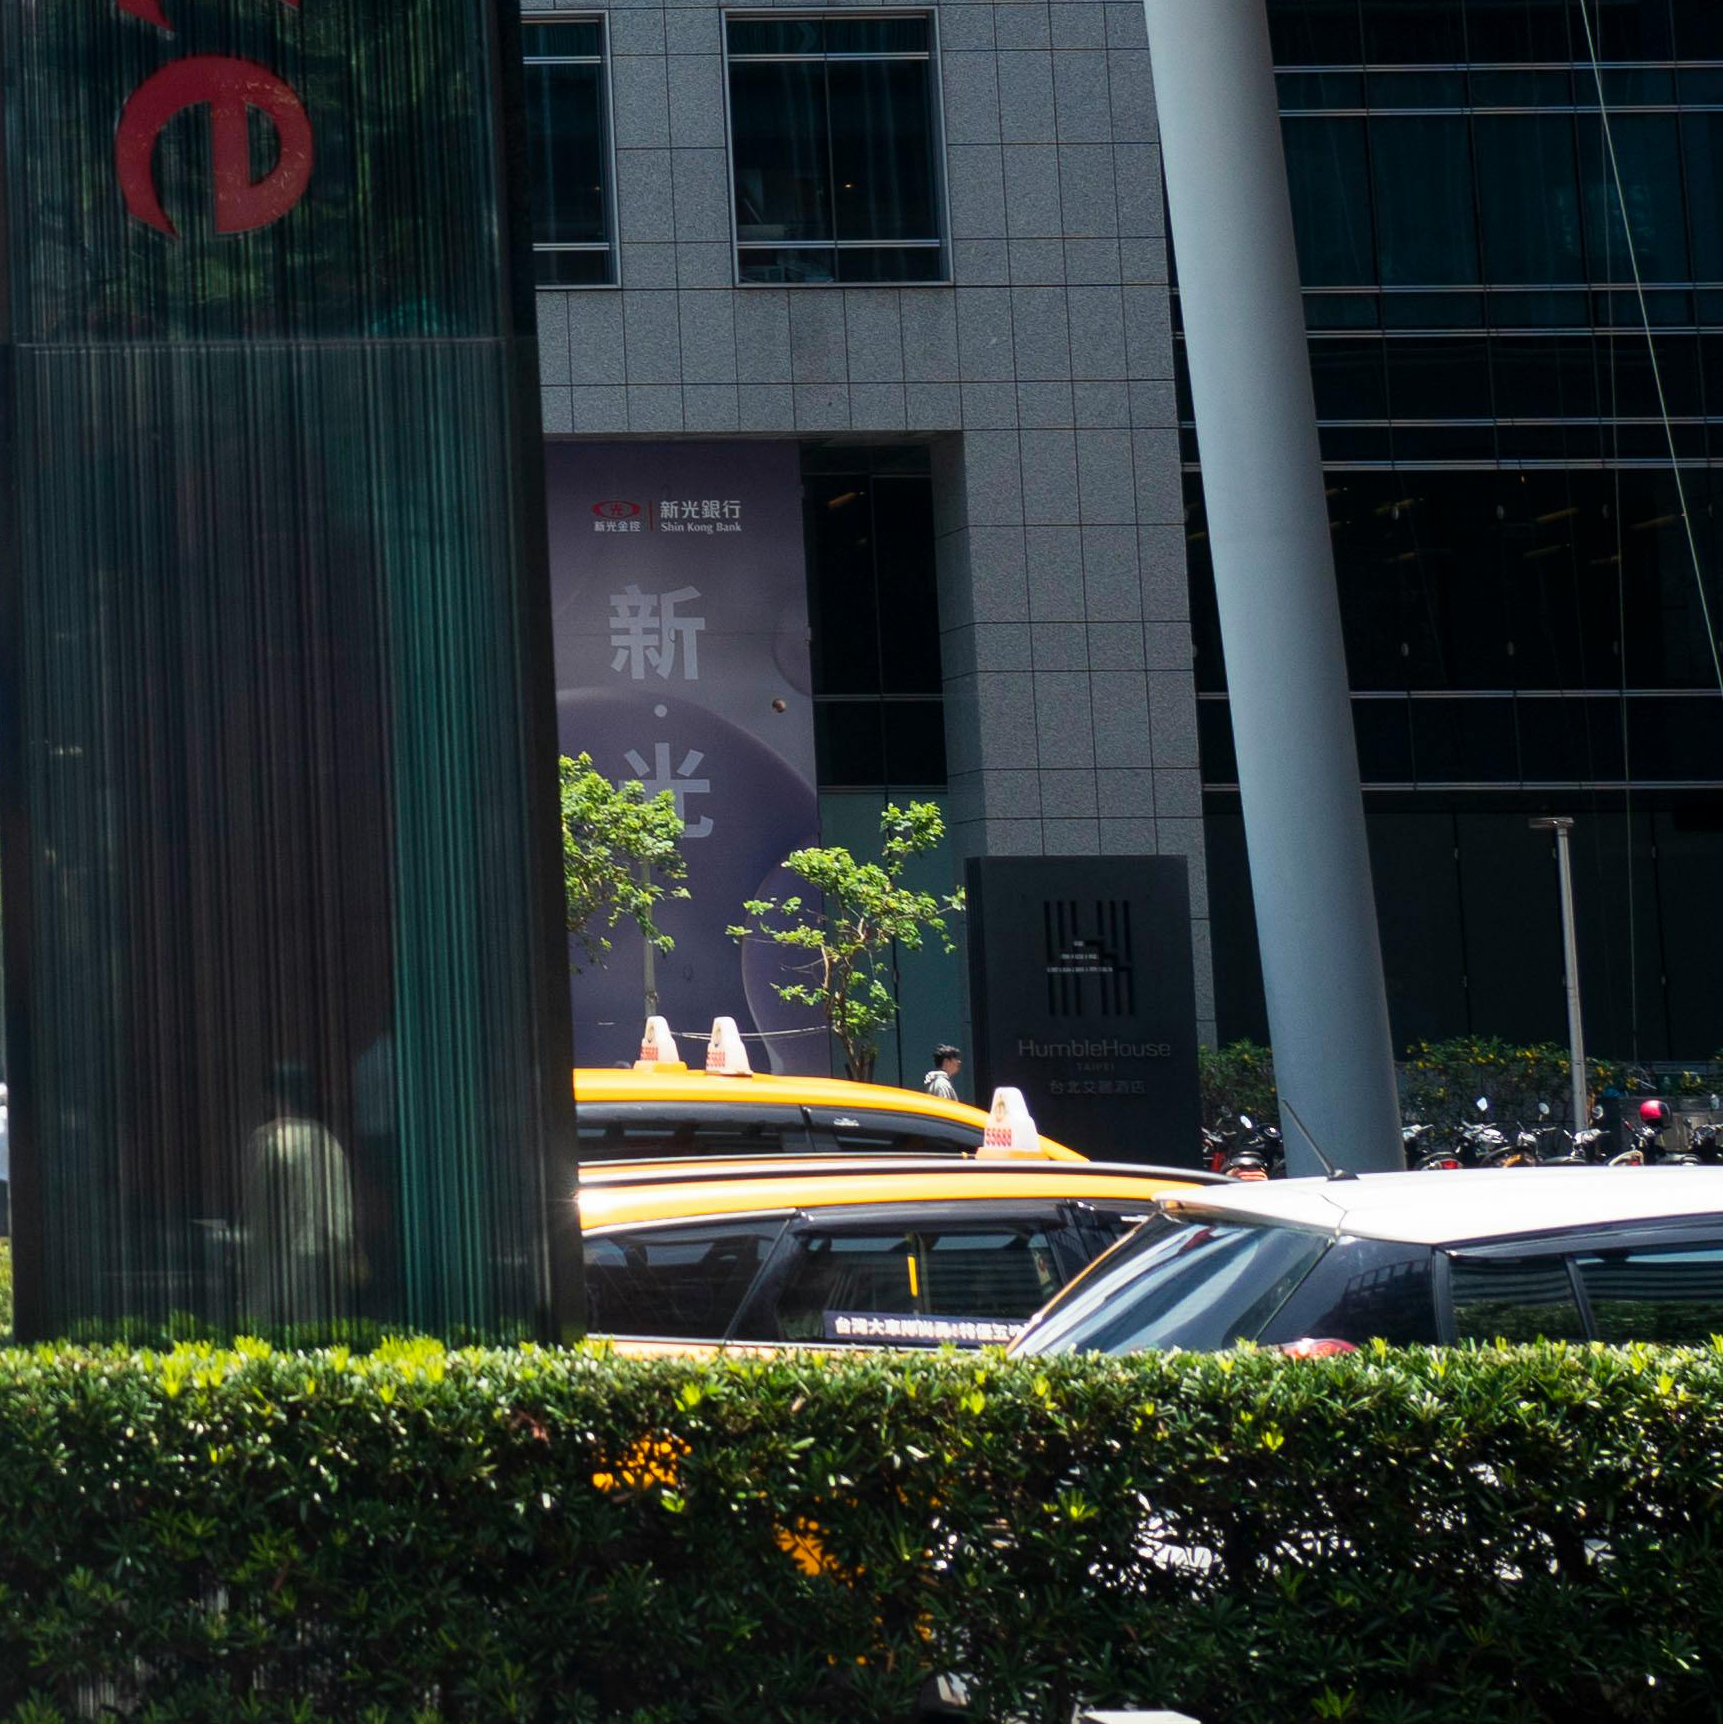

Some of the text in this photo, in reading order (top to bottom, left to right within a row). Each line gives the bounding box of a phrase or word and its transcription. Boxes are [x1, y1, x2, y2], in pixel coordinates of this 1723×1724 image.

[660, 500, 742, 519] 新光銀行
[595, 521, 641, 532] 新光金控
[661, 522, 742, 534] Shin Kong Bank
[1018, 1039, 1171, 1057] HumbleHouse
